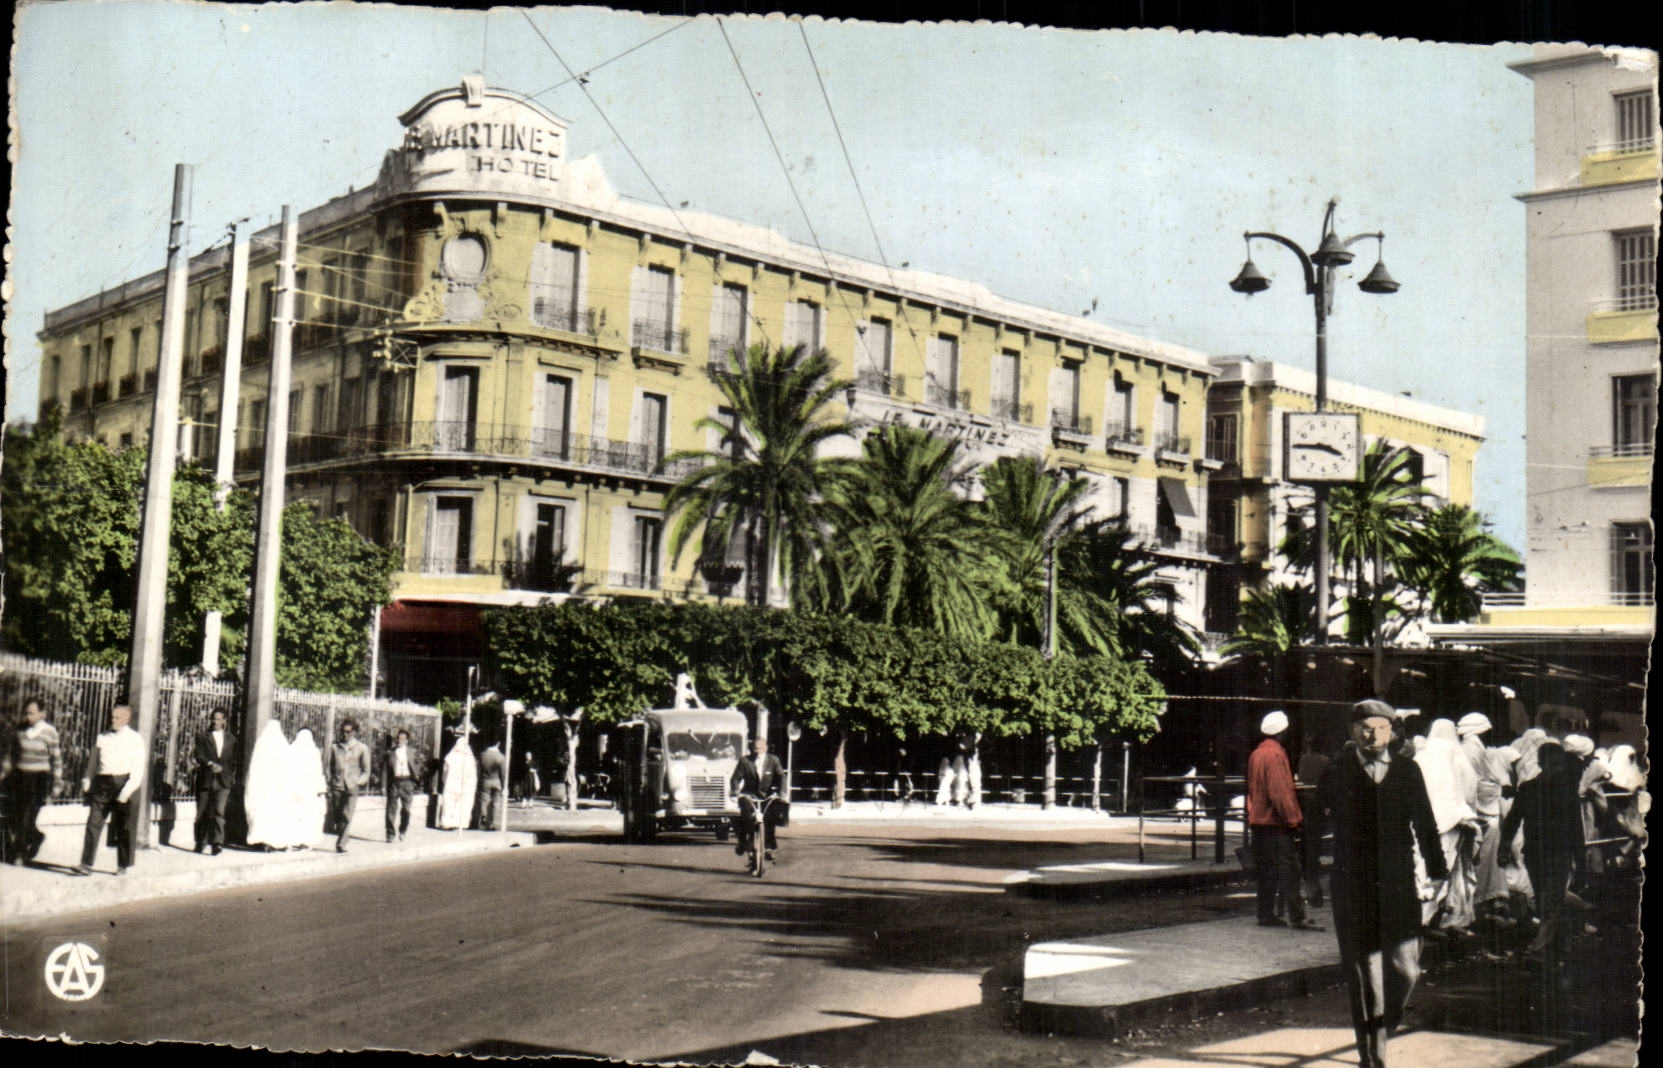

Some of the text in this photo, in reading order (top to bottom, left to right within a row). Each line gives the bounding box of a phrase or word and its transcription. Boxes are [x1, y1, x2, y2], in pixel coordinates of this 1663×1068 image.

[429, 121, 561, 158] MARTINEZ
[471, 155, 560, 182] HOTEL
[918, 416, 1010, 447] MARTINEZ
